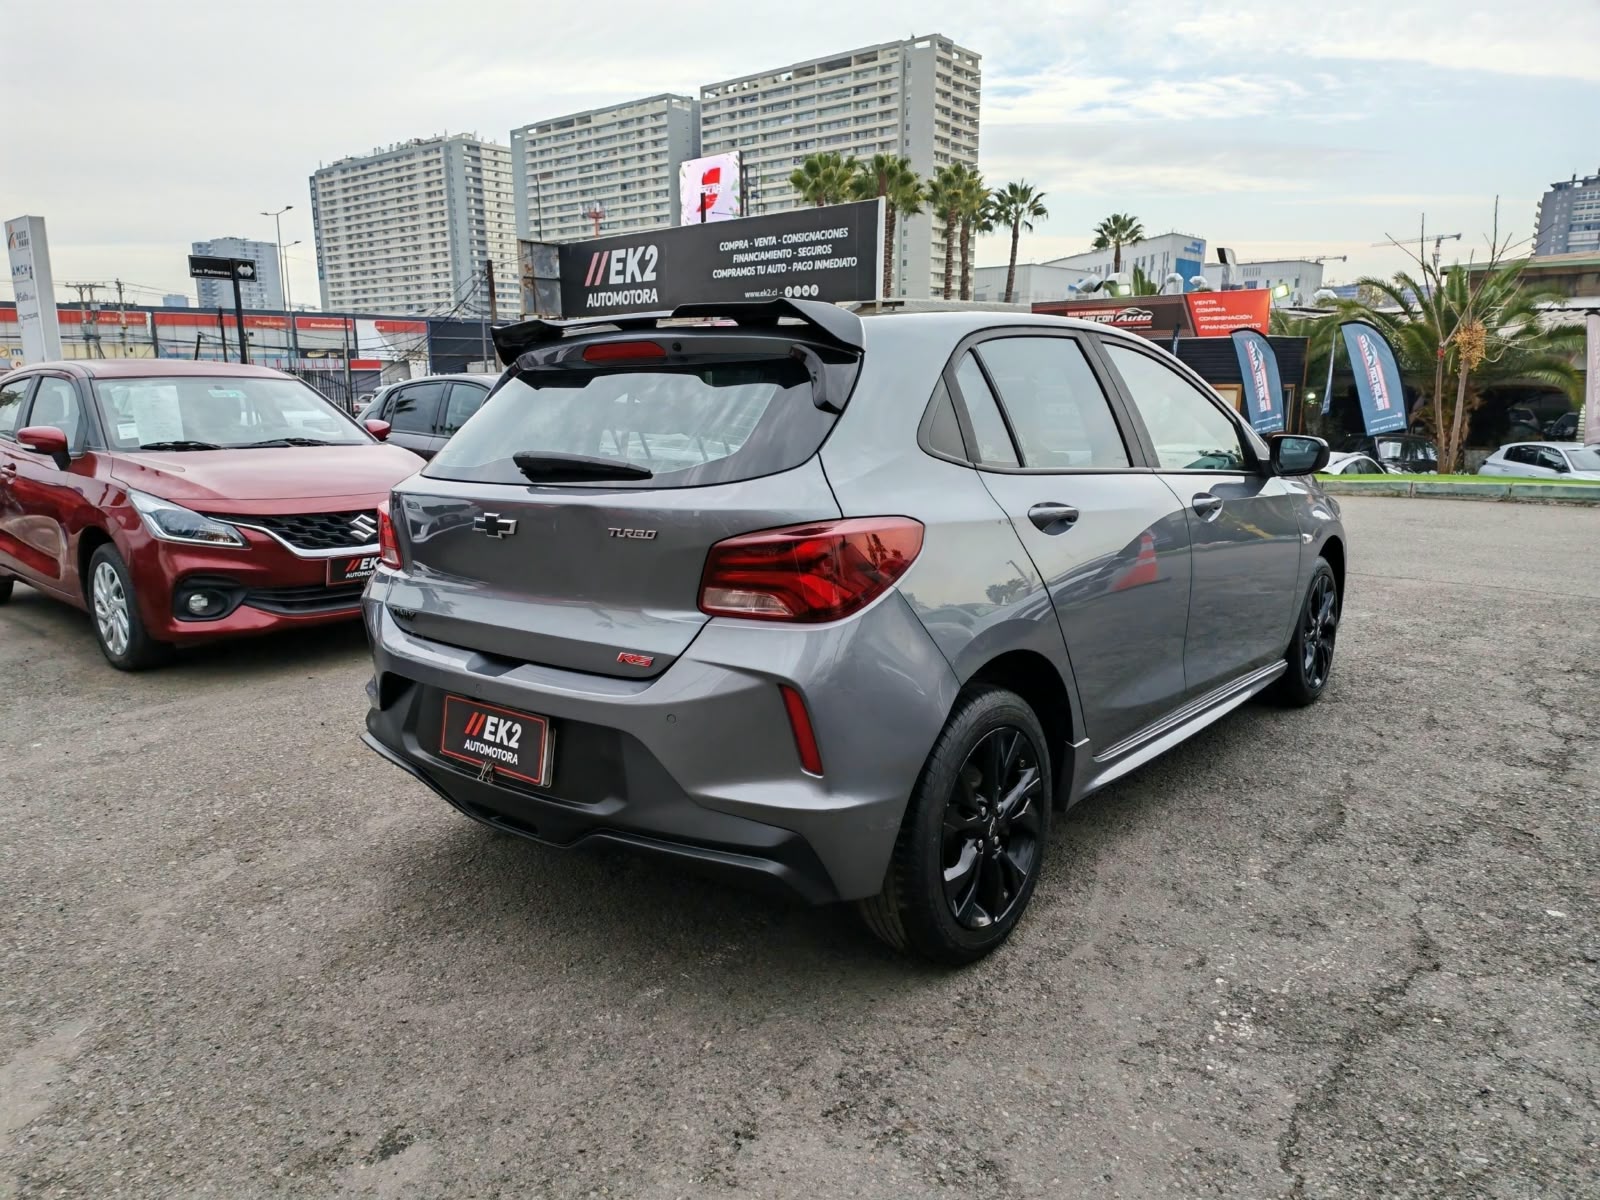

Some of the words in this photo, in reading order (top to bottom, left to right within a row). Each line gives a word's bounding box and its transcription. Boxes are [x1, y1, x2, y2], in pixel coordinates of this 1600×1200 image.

[719, 239, 749, 251] COMPRA
[753, 235, 777, 247] VENTA
[782, 227, 849, 244] CONSIGNACIONES
[732, 248, 792, 264] FINANCIAMIENTO
[797, 243, 833, 257] SEGUROS
[203, 268, 231, 276] Palmeras
[712, 266, 756, 279] COMPRAMOS
[756, 265, 766, 275] TU
[766, 263, 787, 274] AUTO
[792, 260, 814, 272] PAGO
[814, 256, 858, 270] INMEDIATO
[586, 287, 659, 308] AUTOMOTORA
[744, 288, 778, 298] www.ek2.cl
[1116, 314, 1153, 323] Auto
[1199, 322, 1262, 330] FINANCIAMIENTO
[607, 527, 658, 540] TURBO
[345, 570, 375, 579] AUTOMOT
[616, 651, 654, 667] RS
[463, 739, 519, 766] AUTOMOTORA
